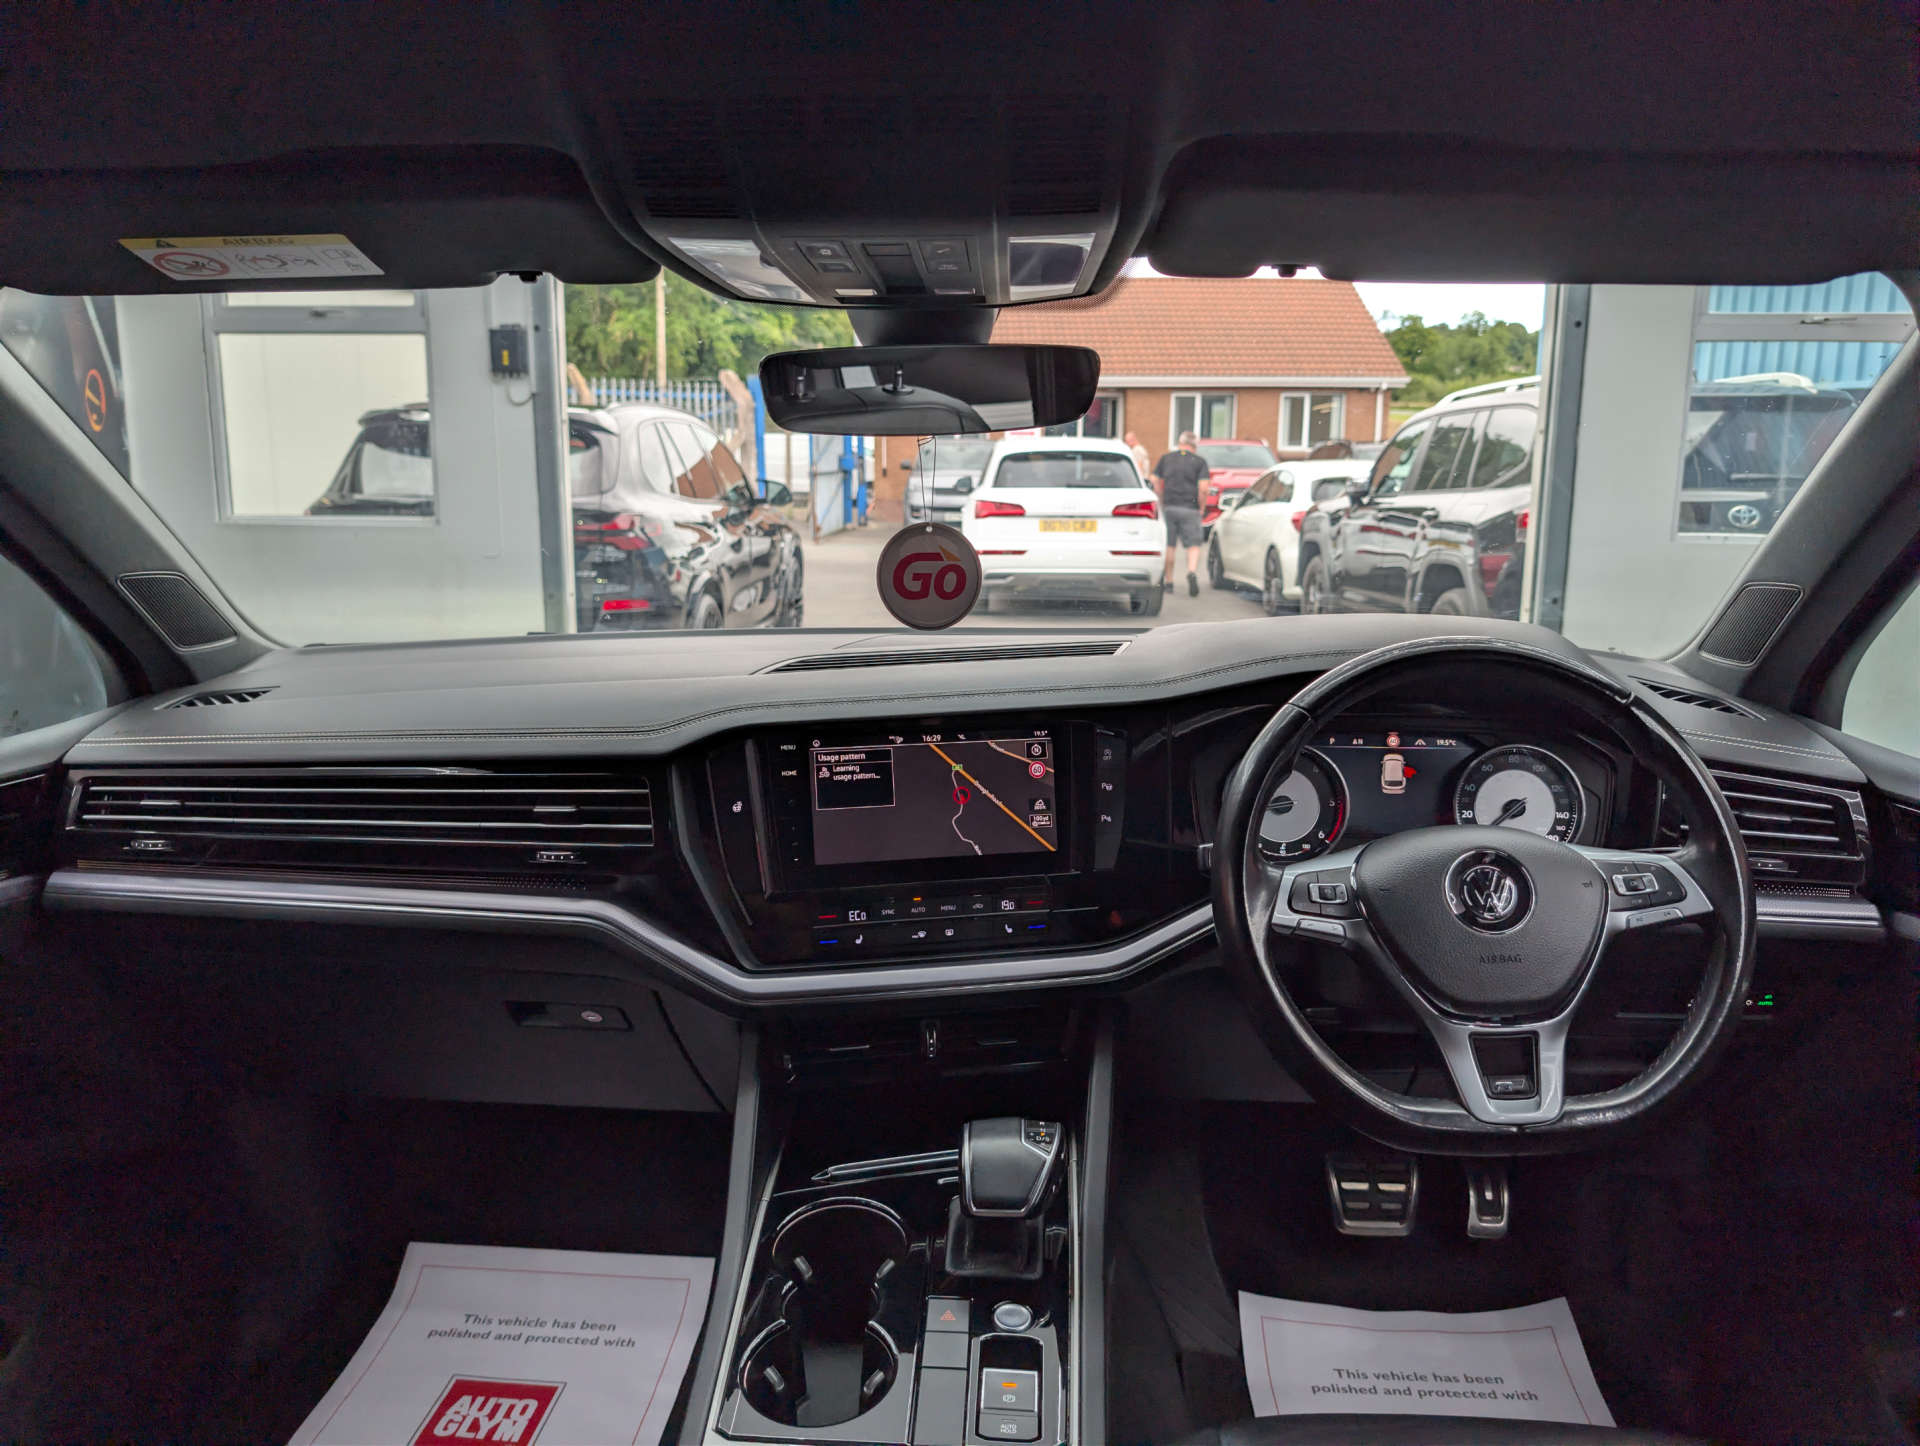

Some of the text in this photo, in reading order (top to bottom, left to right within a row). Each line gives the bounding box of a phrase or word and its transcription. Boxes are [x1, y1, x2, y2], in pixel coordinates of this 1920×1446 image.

[922, 734, 941, 742] 16:29
[818, 753, 865, 762] Usage pattern
[833, 764, 860, 773] Learning
[1033, 765, 1042, 774] 60
[833, 773, 852, 781] usage
[1461, 810, 1473, 818] 20
[1555, 811, 1569, 819] 140
[1318, 831, 1325, 839] 6
[1479, 954, 1522, 964] AIRBAG
[463, 1313, 617, 1332] This vehicle has been
[427, 1327, 636, 1348] polished and protected with
[1333, 1368, 1505, 1385] This vehicle has been
[1311, 1383, 1539, 1401] polished and protected with
[445, 1395, 539, 1420] AUTO
[433, 1414, 529, 1442] GLYM
